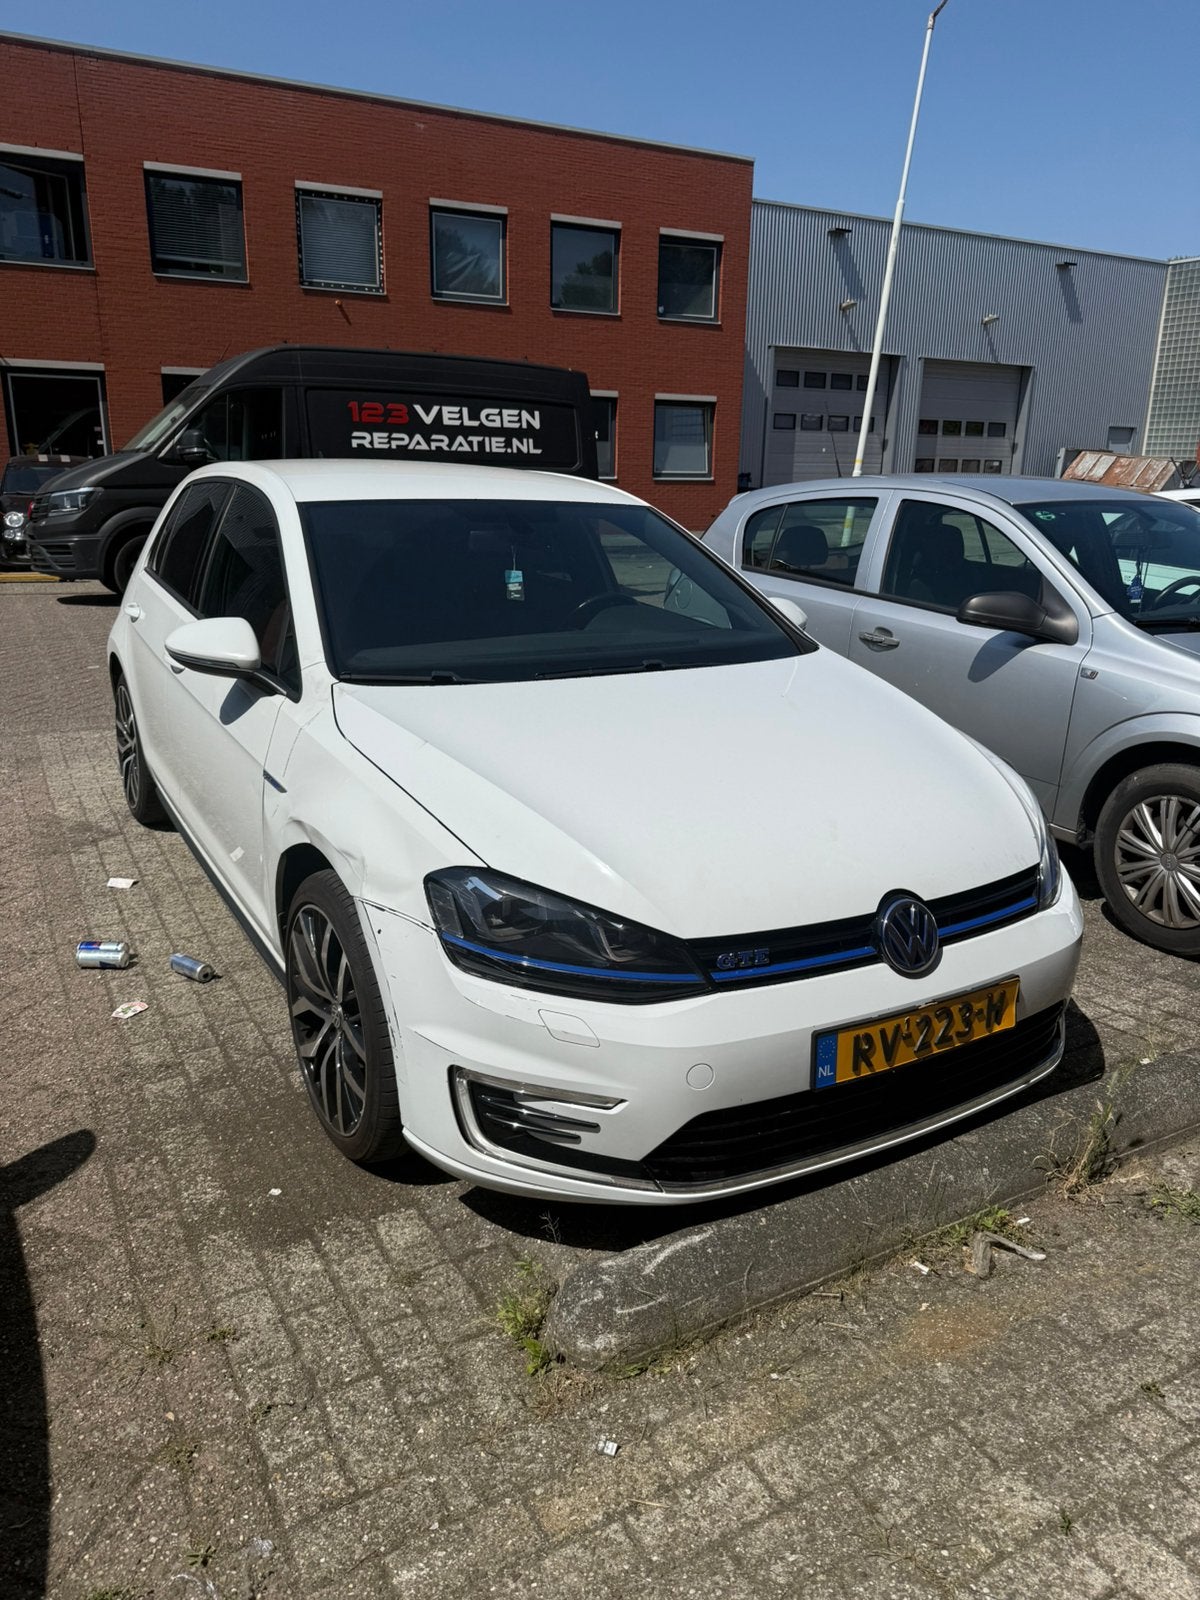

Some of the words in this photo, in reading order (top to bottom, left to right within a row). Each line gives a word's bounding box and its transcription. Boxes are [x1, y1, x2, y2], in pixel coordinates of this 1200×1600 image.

[347, 401, 409, 425] 123
[413, 404, 541, 430] VELGEN
[351, 431, 542, 454] REPARATIE.NL
[716, 948, 769, 970] GTE
[818, 1065, 833, 1078] NL
